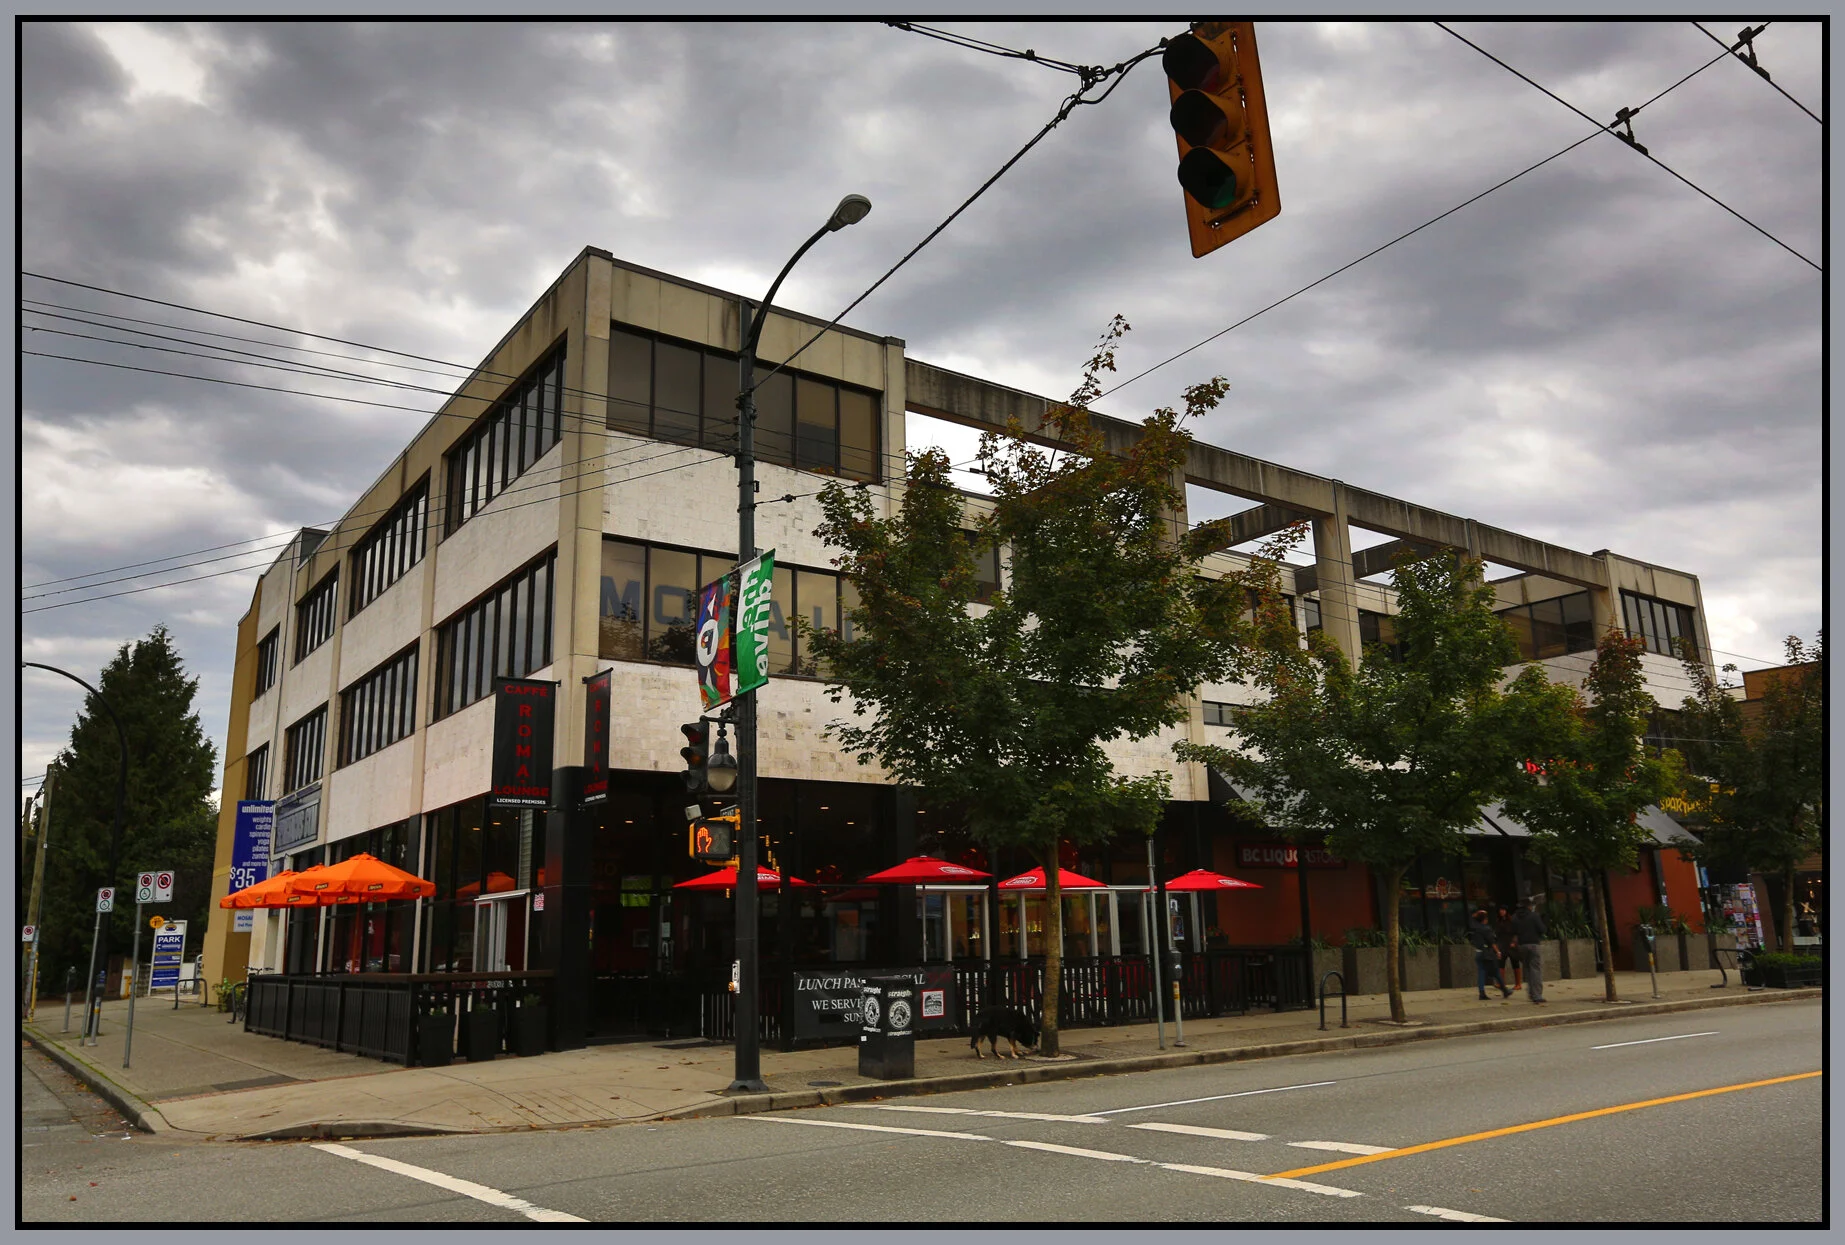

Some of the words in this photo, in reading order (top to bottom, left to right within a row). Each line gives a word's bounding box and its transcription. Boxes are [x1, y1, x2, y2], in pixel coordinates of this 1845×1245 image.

[515, 704, 532, 777] ROMA
[493, 785, 549, 797] LOUNGE
[241, 804, 274, 813] unlimited
[1242, 848, 1260, 862] BC
[229, 866, 256, 888] $35
[797, 978, 841, 991] LUNCH
[811, 1000, 829, 1010] WE
